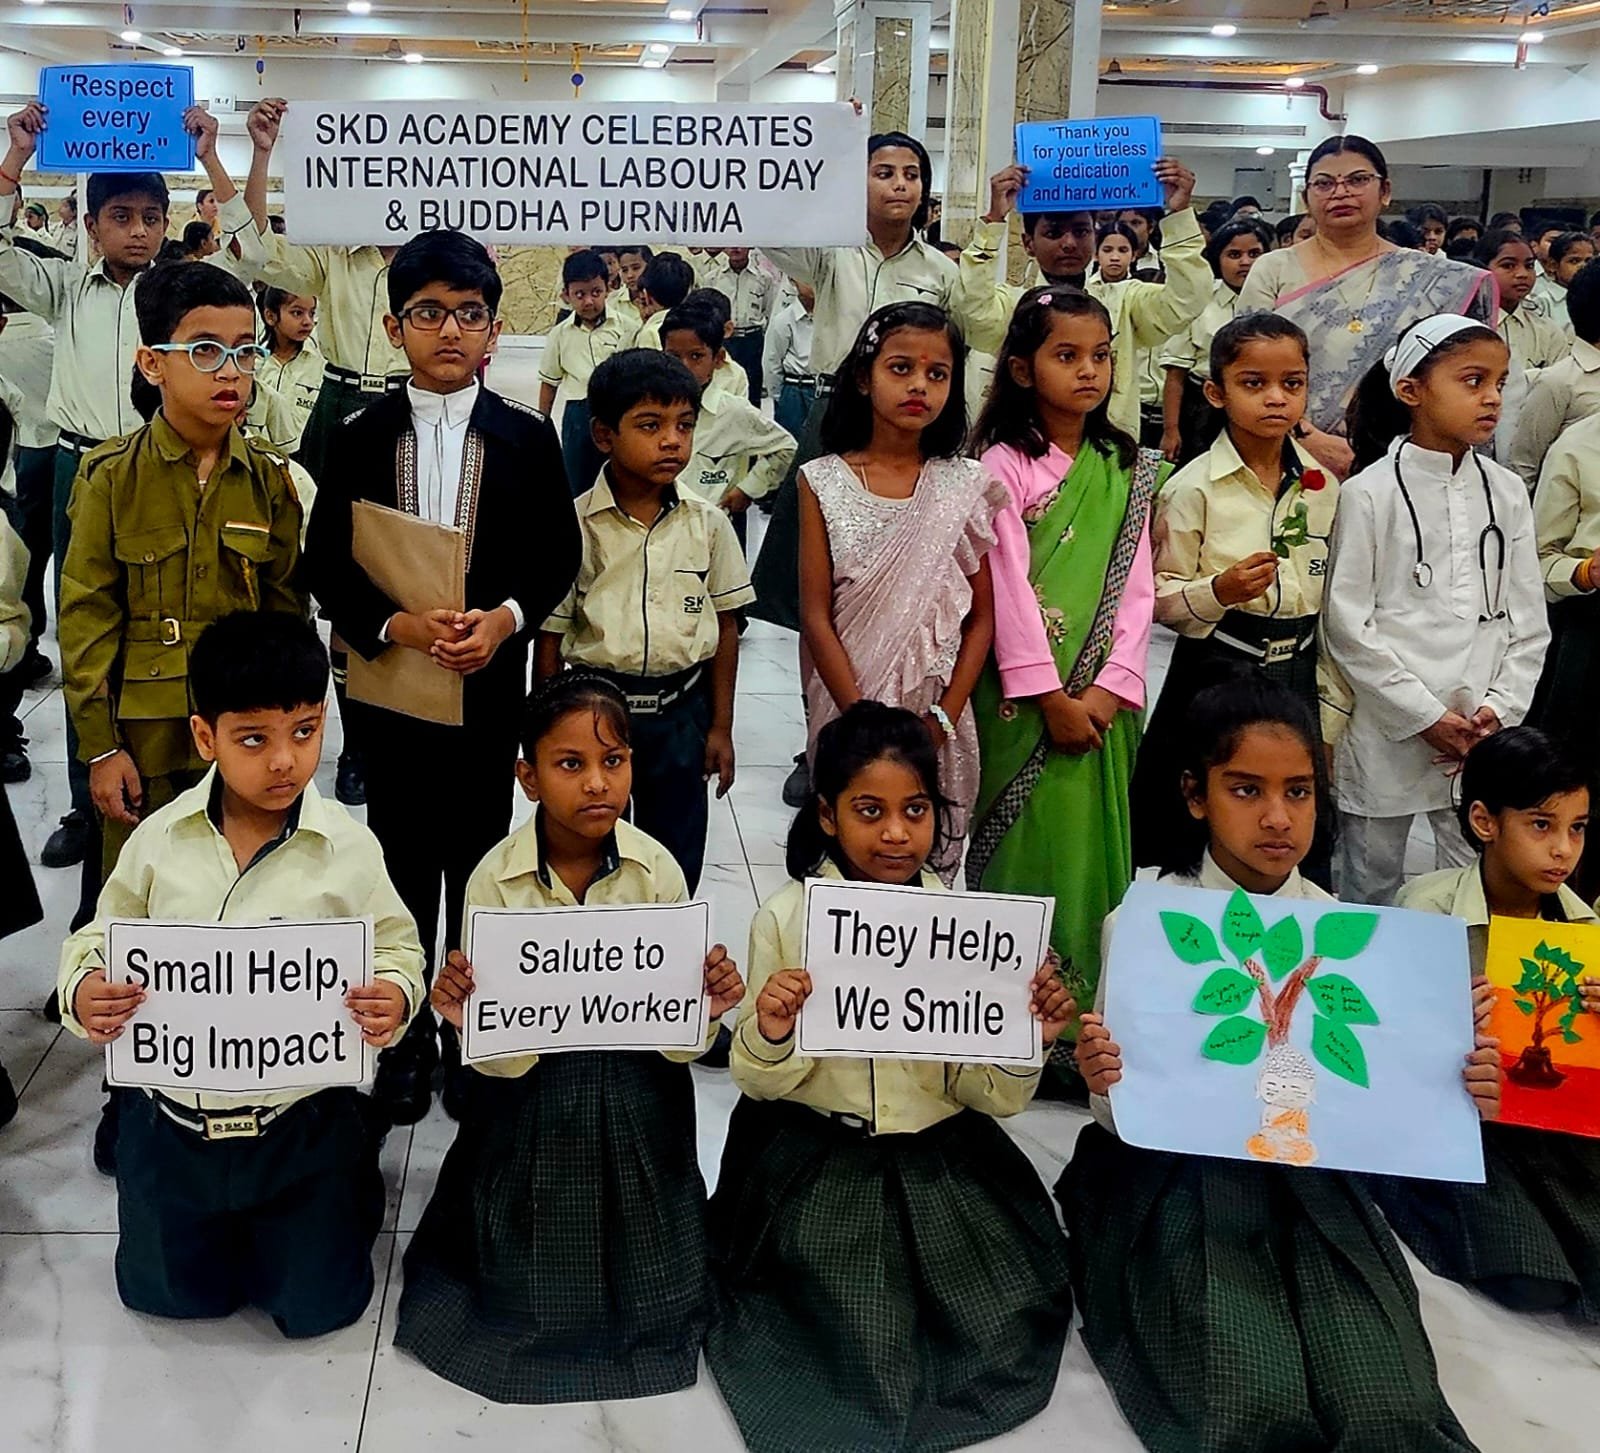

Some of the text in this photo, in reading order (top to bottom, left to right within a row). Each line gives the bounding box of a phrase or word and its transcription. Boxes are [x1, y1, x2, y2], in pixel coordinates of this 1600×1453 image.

[61, 74, 174, 102] "Respect
[82, 110, 151, 134] every
[316, 113, 813, 147] SKD ACADEMY CELEBRATES
[1048, 125, 1130, 140] "Thank you
[64, 136, 168, 161] worker."
[1033, 142, 1147, 161] for your tireless
[305, 156, 824, 191] INTERNATIONAL LABOUR DAY
[1053, 162, 1129, 179] dedication
[1033, 182, 1149, 201] and hard work."
[385, 200, 743, 233] & BUDDHA PURNIMA
[684, 596, 705, 607] SK
[519, 936, 664, 974] Salute to
[827, 909, 1022, 971] They Help,
[126, 948, 348, 1001] Small Help,
[478, 992, 697, 1034] Every Worker
[835, 986, 1004, 1036] We Smile
[133, 1021, 346, 1080] Big Impact
